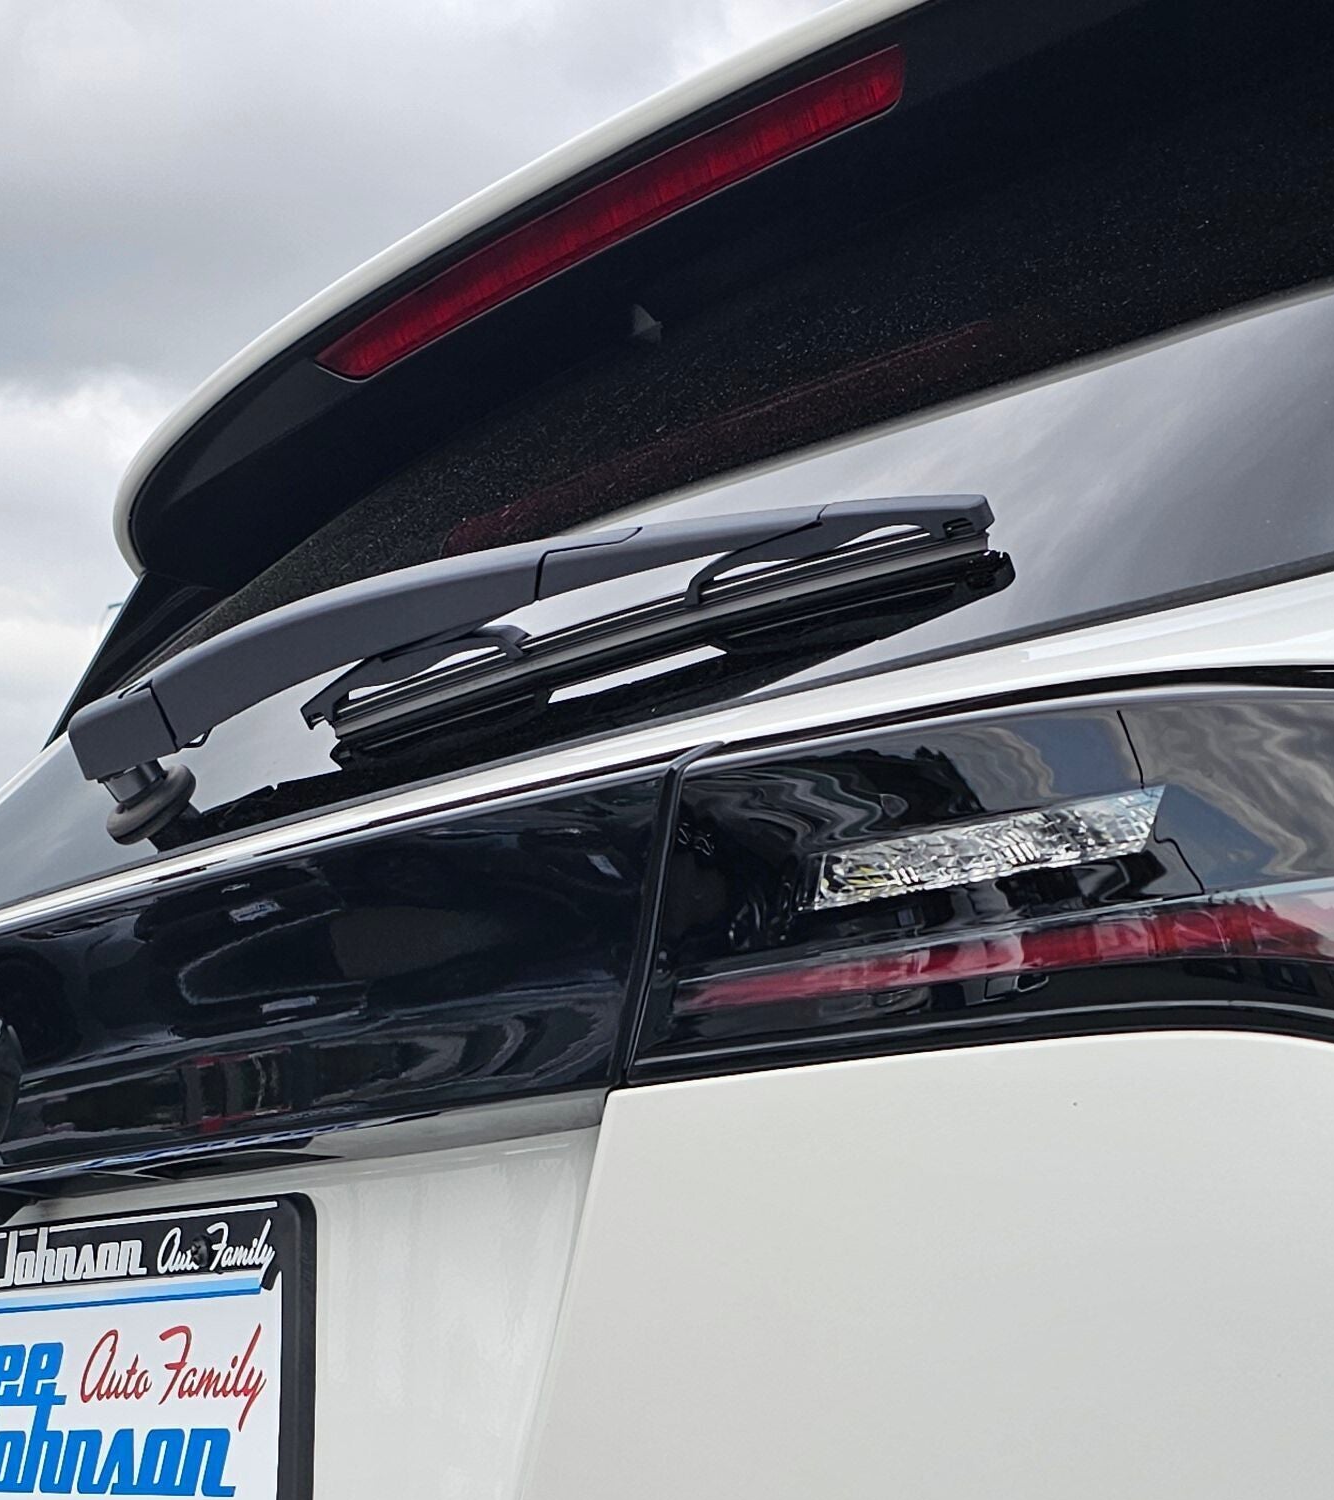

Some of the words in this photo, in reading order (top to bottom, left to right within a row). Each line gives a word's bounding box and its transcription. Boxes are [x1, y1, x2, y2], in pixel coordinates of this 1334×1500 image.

[156, 1226, 207, 1275] Aut
[207, 1218, 276, 1287] Family
[80, 1329, 152, 1404] Auto
[159, 1323, 268, 1431] Family
